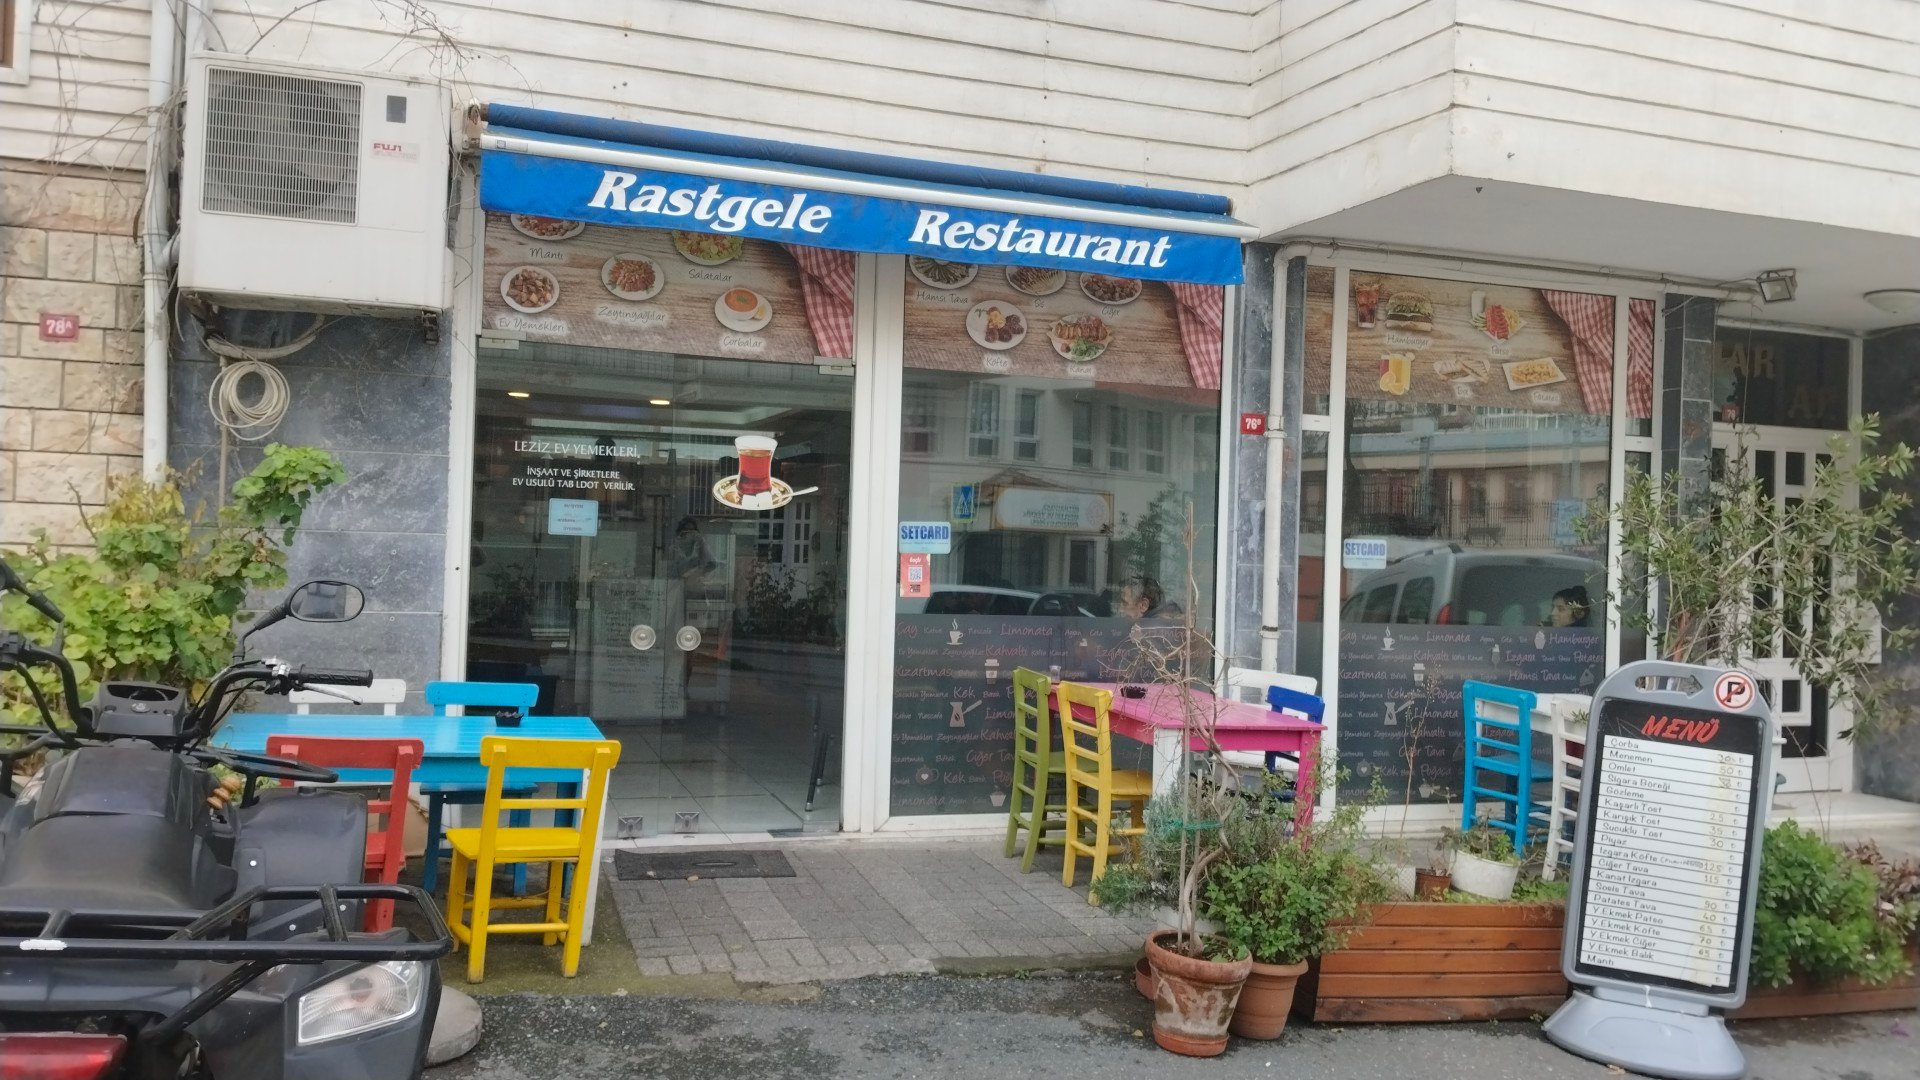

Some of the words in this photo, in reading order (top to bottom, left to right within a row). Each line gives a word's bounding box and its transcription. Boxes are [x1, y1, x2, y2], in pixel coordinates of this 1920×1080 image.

[373, 143, 402, 152] FUJI
[588, 170, 833, 234] Rastgele
[908, 209, 1172, 269] Restaurant
[688, 268, 733, 282] Salatalar
[514, 440, 551, 453] LEZİZ
[554, 442, 570, 454] EV
[527, 465, 559, 477] İNŞAAT
[560, 468, 572, 477] VE
[573, 467, 621, 480] ŞİRKETLERE
[512, 478, 524, 486] EV
[525, 478, 555, 487] USULÜ
[575, 481, 599, 490] LDOT
[901, 525, 949, 540] SETCARD
[1345, 542, 1386, 556] SETCARD
[1000, 623, 1053, 637] Limonata
[1425, 630, 1471, 643] Limonata
[1549, 632, 1600, 649] Hamburger
[953, 685, 976, 699] Kek
[1640, 714, 1720, 744] MENÜ
[1609, 750, 1653, 763] Menemen
[1608, 762, 1636, 772] Omlet
[943, 770, 966, 784] Kek
[1607, 773, 1638, 786] Sigara
[1641, 802, 1662, 813] Tost
[1640, 815, 1660, 826] Tost
[1602, 821, 1638, 835] Sucuklu
[1642, 828, 1663, 838] Tost
[1600, 834, 1628, 847] Piyaz
[1599, 846, 1629, 859] Izgara
[1703, 861, 1722, 873] 125
[1625, 862, 1649, 873] Tava
[1596, 870, 1626, 881] Kanat
[1628, 877, 1657, 888] Izgara
[1595, 881, 1619, 893] Sosis
[1622, 886, 1646, 897] Tava
[1593, 893, 1631, 907] Patates
[1633, 900, 1657, 911] Tava
[1635, 912, 1664, 924] Patso
[1699, 935, 1712, 945] 70
[1631, 948, 1655, 960] Balık
